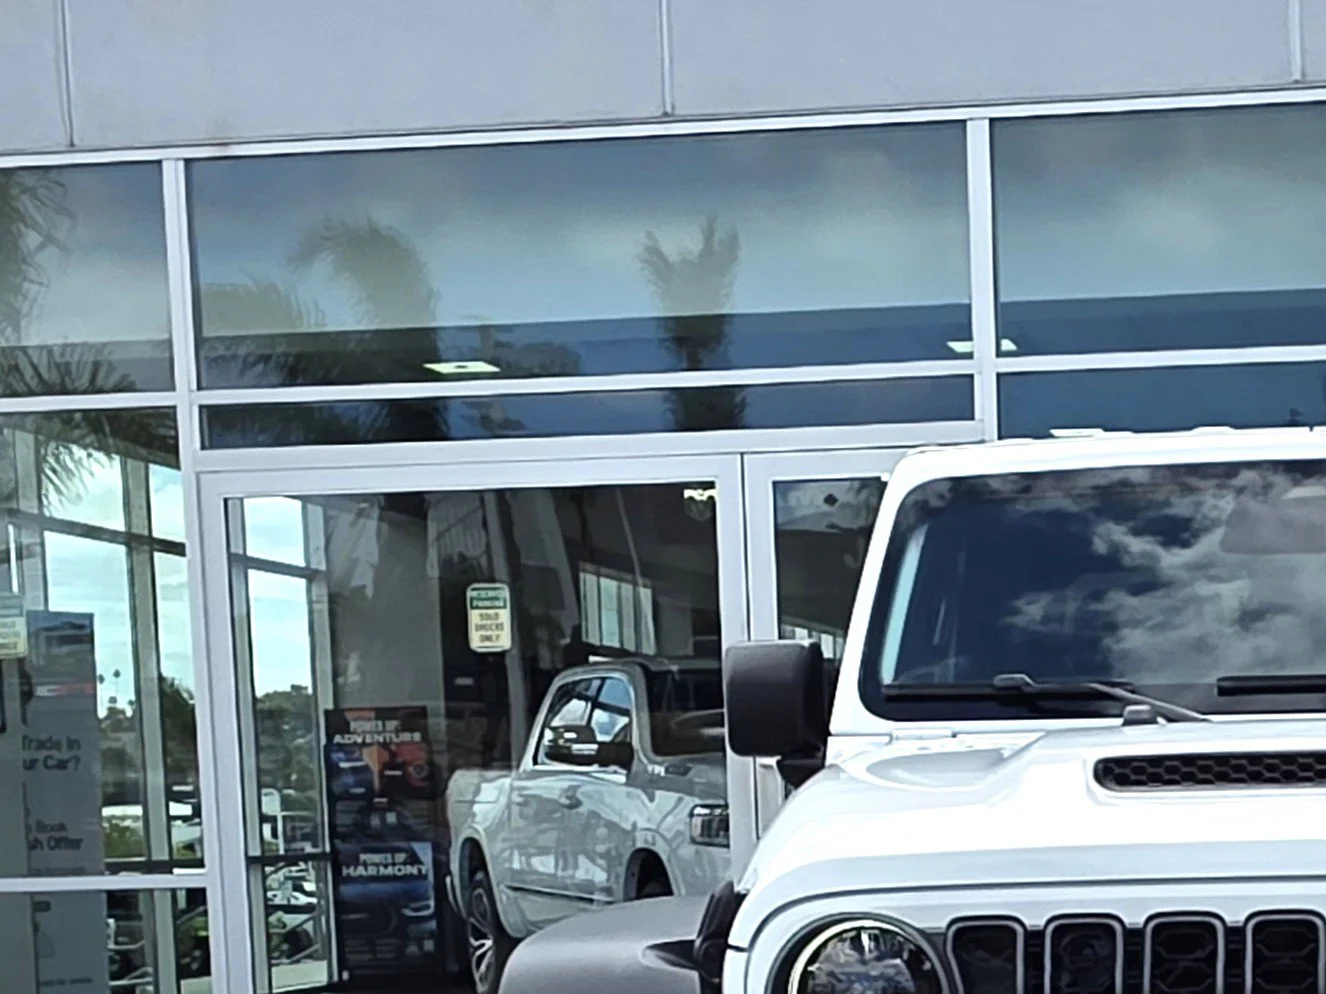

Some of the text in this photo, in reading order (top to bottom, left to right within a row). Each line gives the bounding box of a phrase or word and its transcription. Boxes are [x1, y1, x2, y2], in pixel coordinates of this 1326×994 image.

[333, 731, 422, 744] ADVENTURE
[42, 754, 81, 772] Car?
[46, 836, 84, 851] Offer
[342, 865, 428, 877] HARMONY
